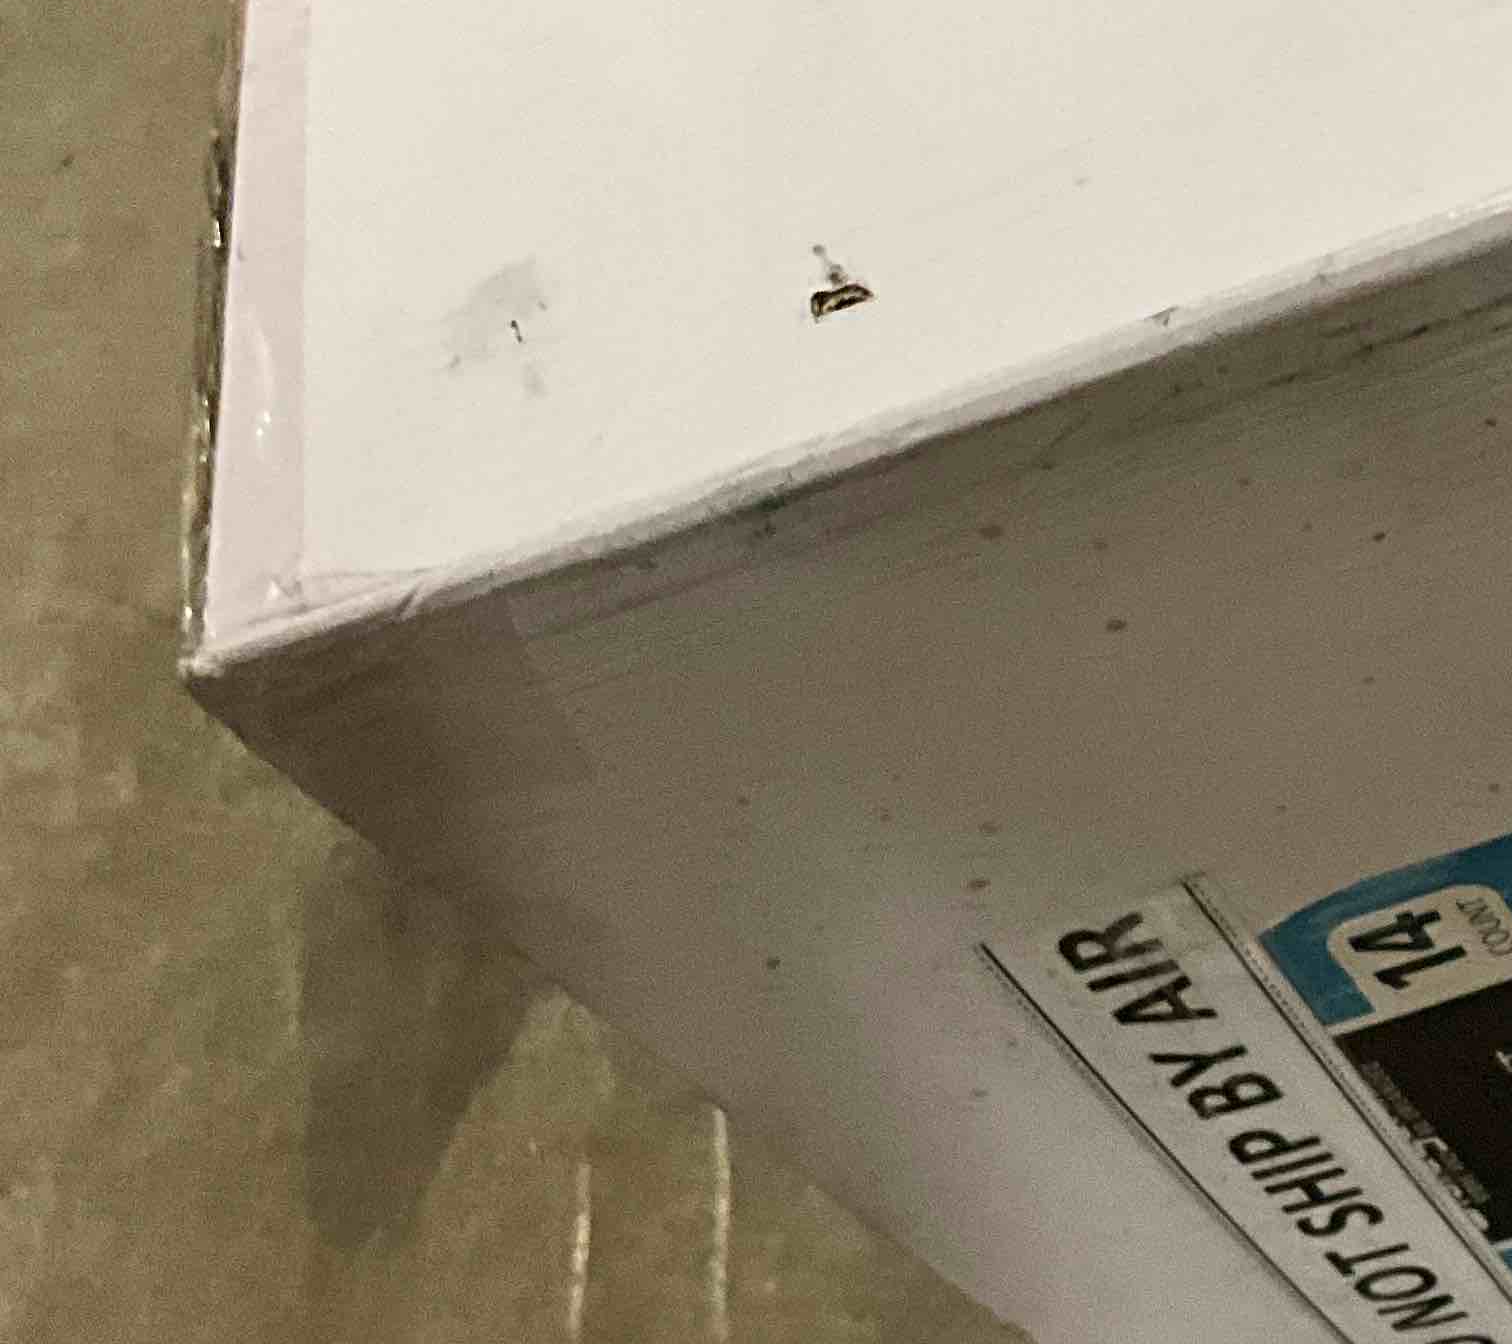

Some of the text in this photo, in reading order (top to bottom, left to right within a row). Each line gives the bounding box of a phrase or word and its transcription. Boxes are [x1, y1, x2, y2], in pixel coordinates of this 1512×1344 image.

[1057, 911, 1219, 1027] AIR
[1349, 910, 1466, 991] 14
[1150, 1044, 1284, 1122] BY
[1228, 1135, 1384, 1242] SHIP
[1325, 1245, 1469, 1344] NOT
